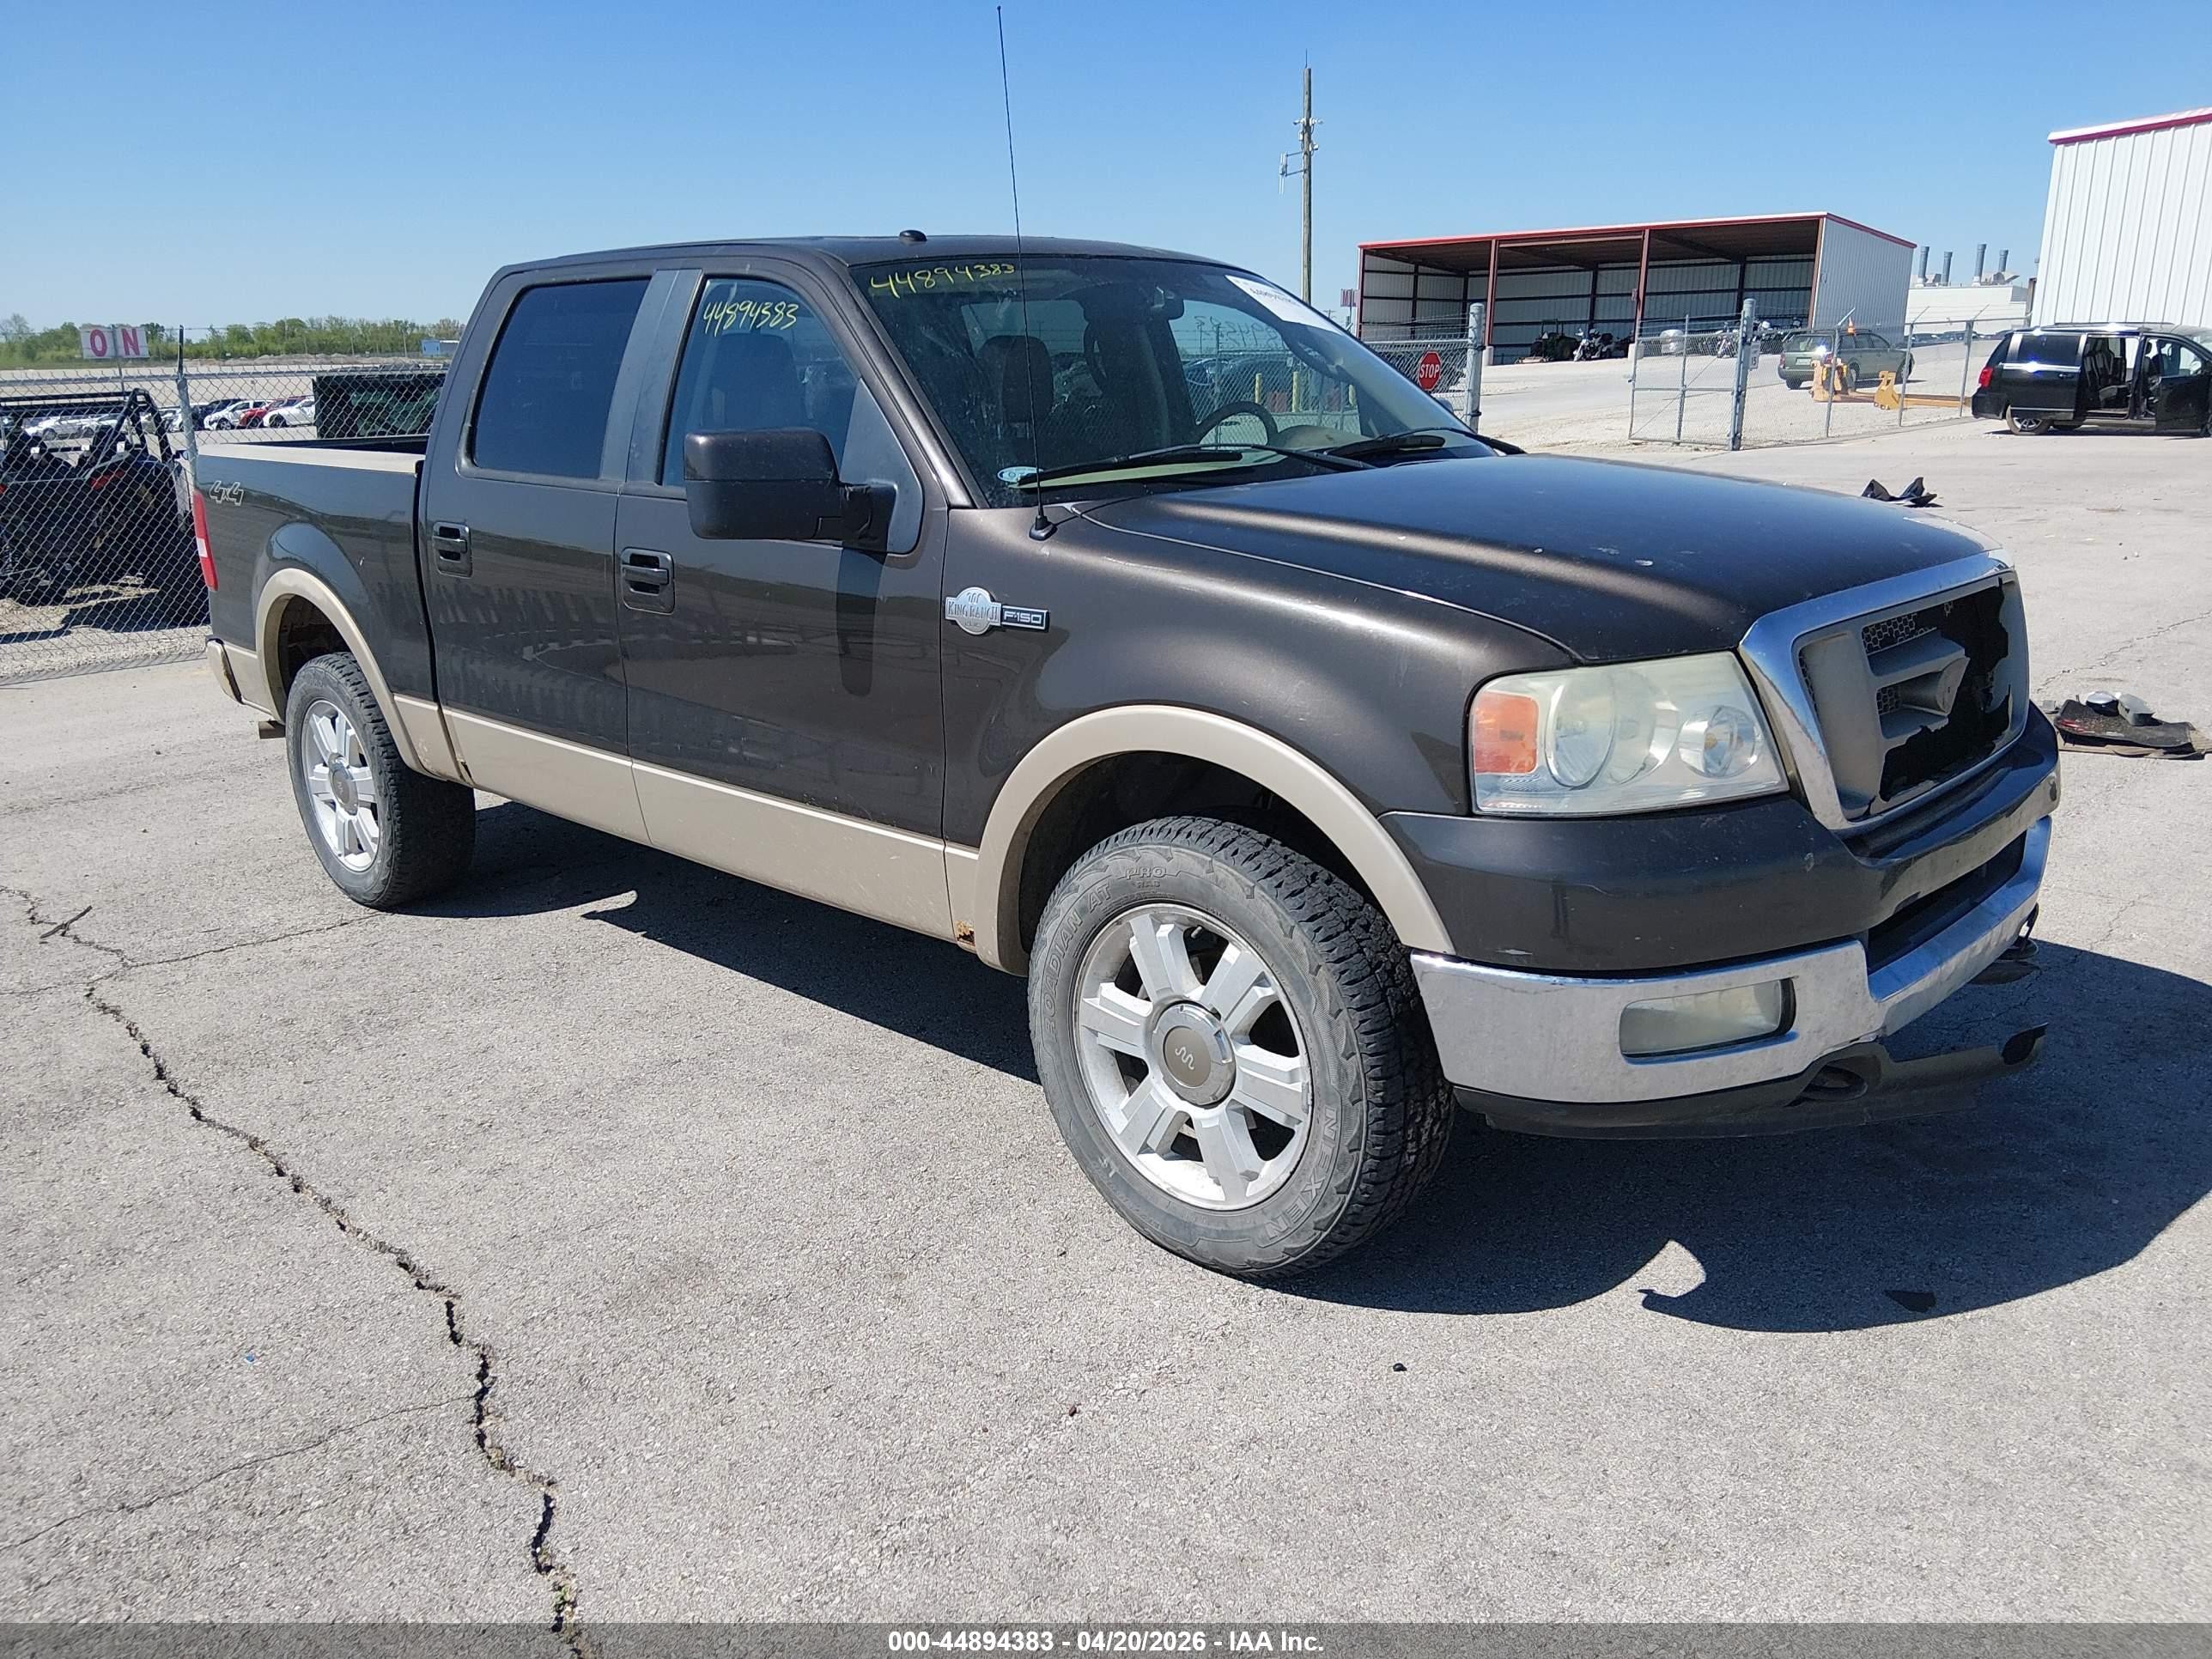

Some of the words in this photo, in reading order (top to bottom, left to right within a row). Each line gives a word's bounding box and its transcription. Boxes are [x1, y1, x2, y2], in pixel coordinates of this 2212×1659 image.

[871, 264, 1015, 299] 44894383
[703, 301, 799, 337] 44894383
[1419, 363, 1440, 379] STOP
[948, 600, 968, 619] KING
[969, 605, 998, 623] RANCH
[1125, 865, 1168, 880] PRO
[1043, 910, 1084, 1042] ROADIAN
[1087, 882, 1115, 915] AT
[1264, 1106, 1338, 1241] NEXEN
